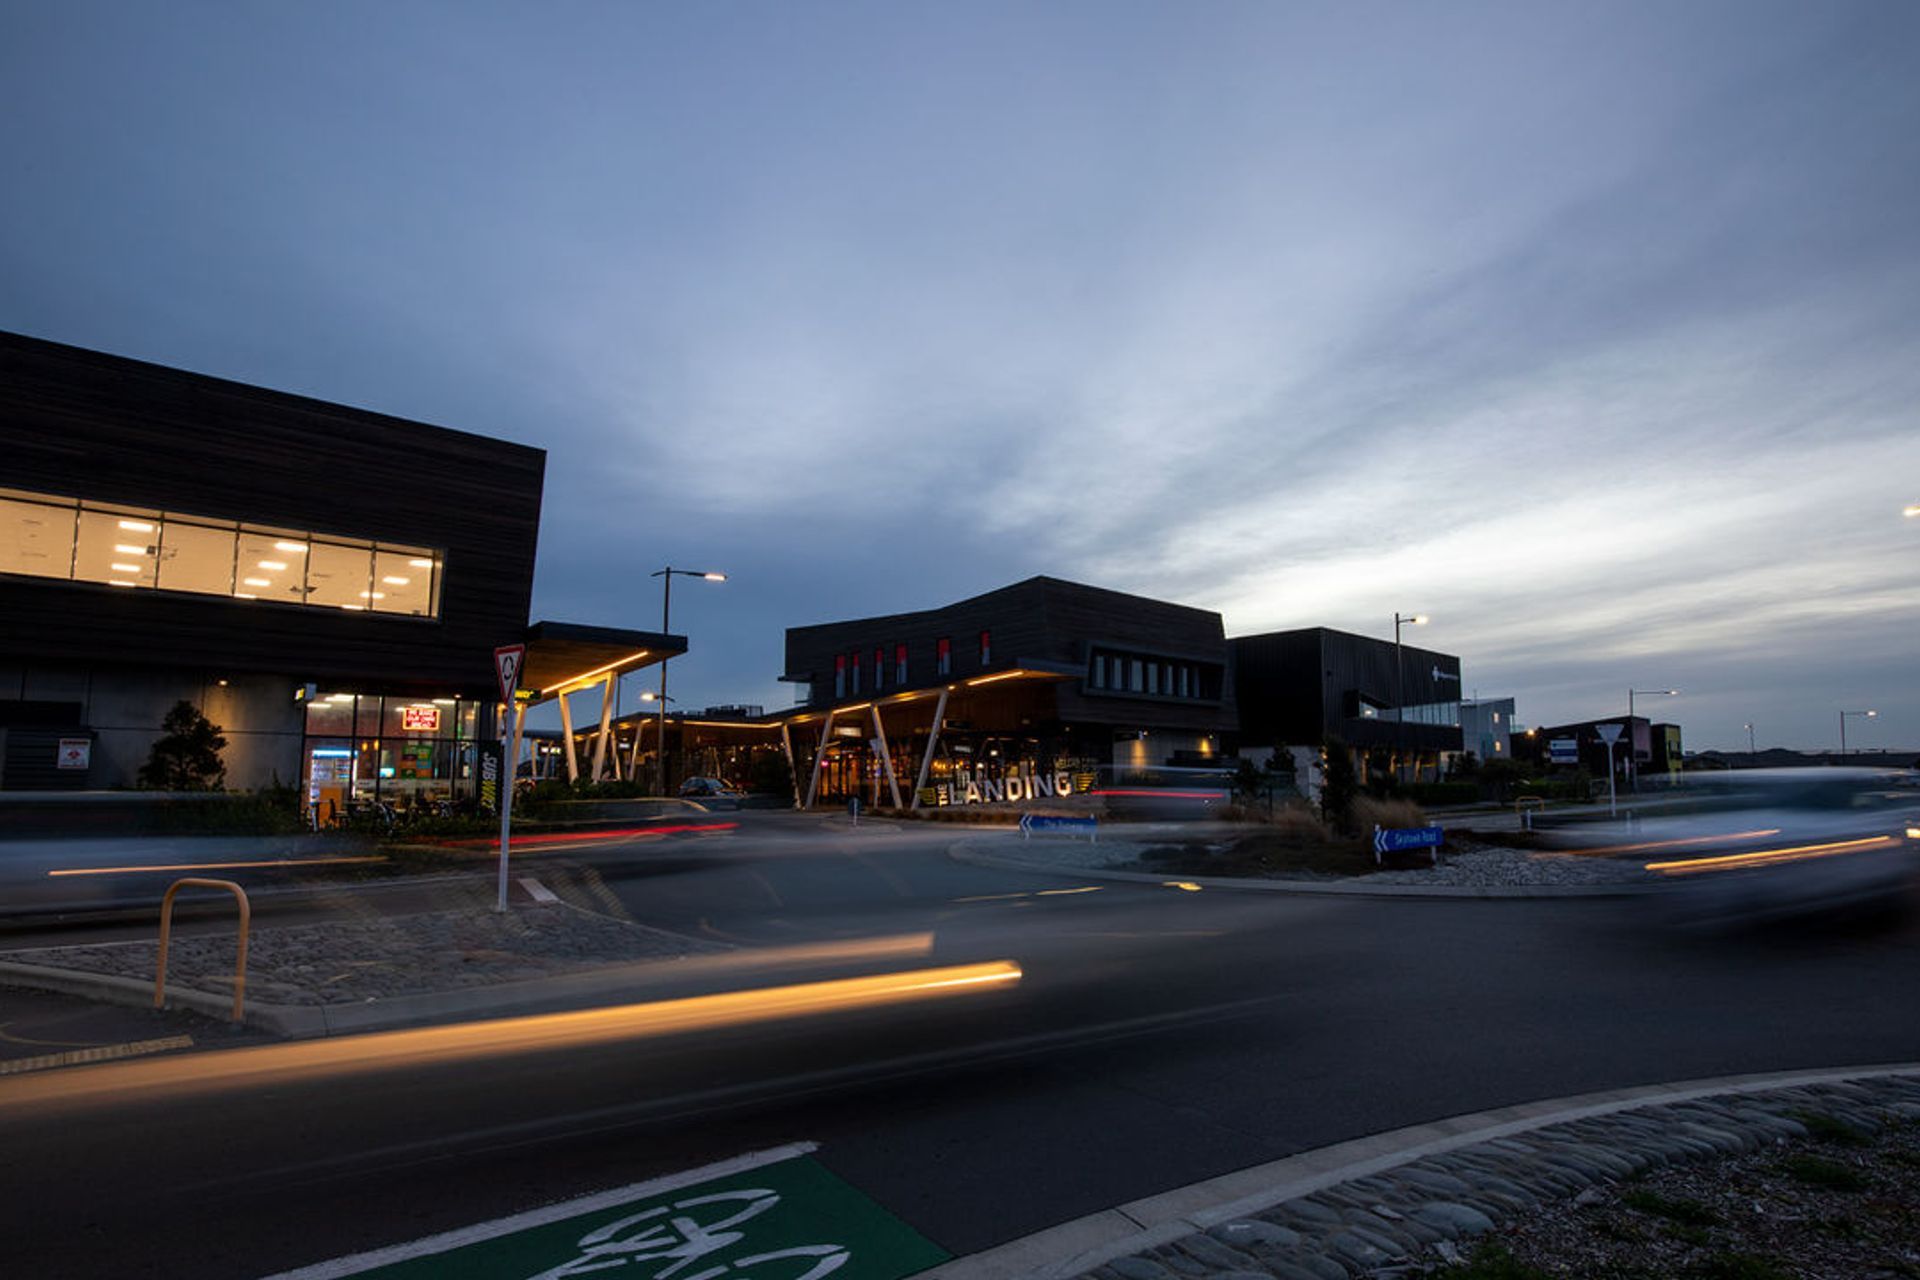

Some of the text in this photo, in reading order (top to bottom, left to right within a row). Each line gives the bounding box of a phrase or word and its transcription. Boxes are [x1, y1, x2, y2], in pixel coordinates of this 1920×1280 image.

[482, 752, 497, 813] SUBWAY
[937, 771, 1072, 807] THE LANDING
